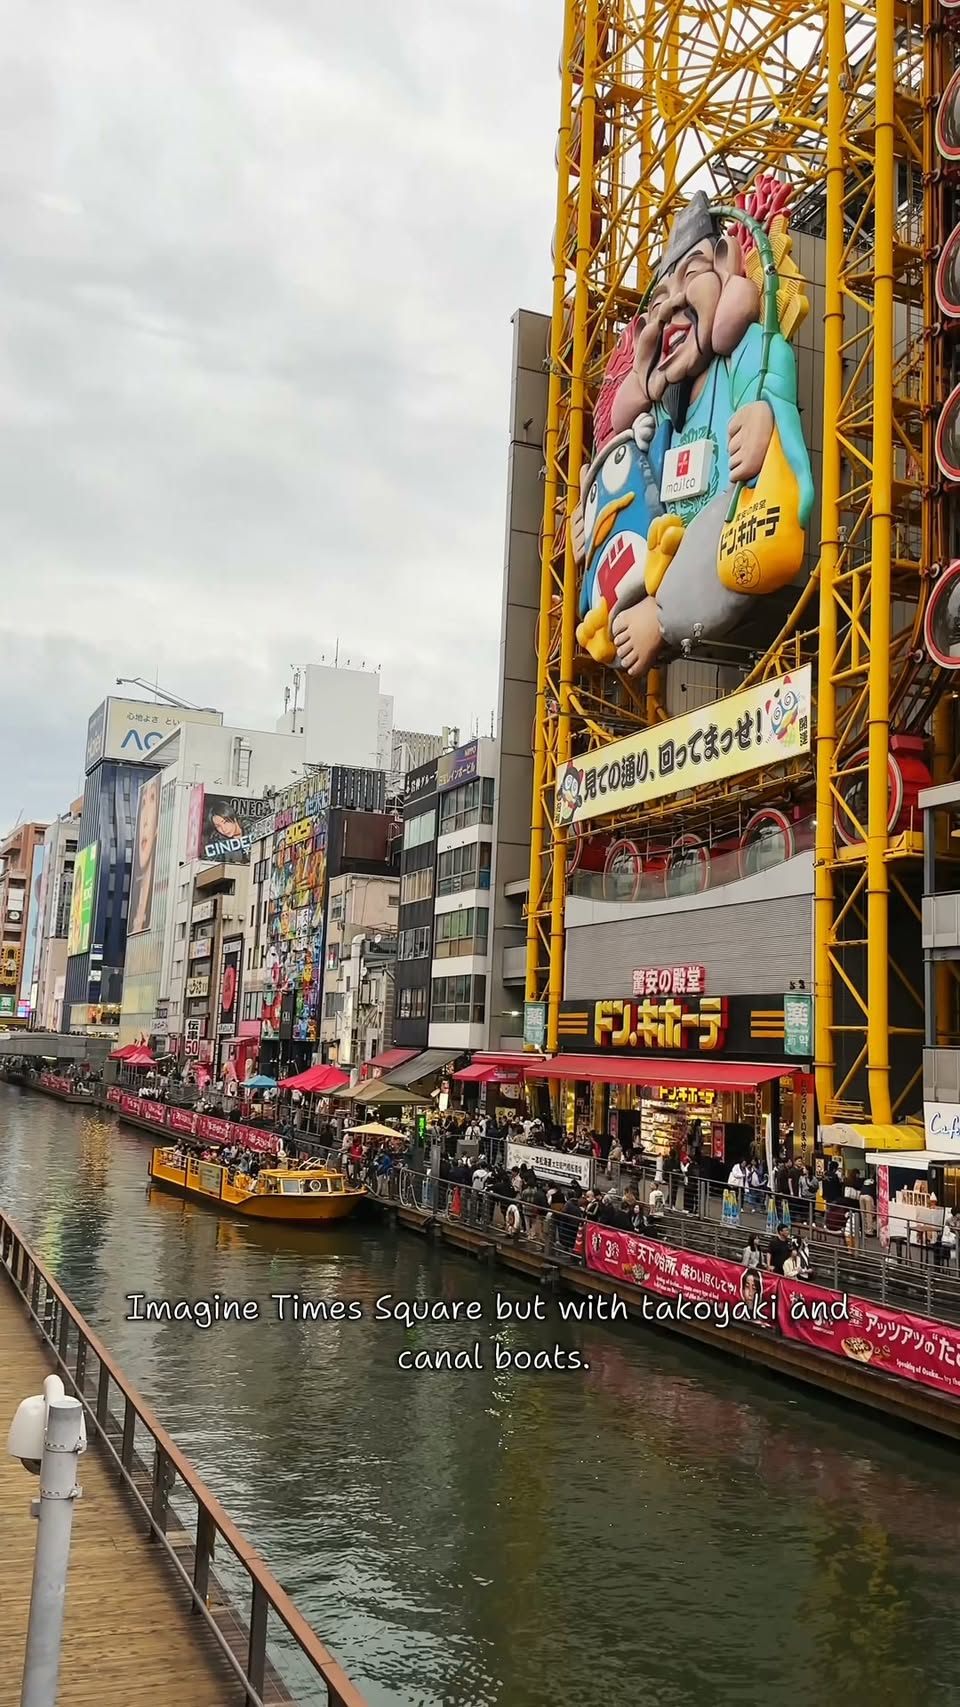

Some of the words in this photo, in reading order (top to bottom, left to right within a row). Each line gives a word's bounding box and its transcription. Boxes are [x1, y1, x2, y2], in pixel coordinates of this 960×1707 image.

[632, 966, 702, 996] 驚安の殿堂
